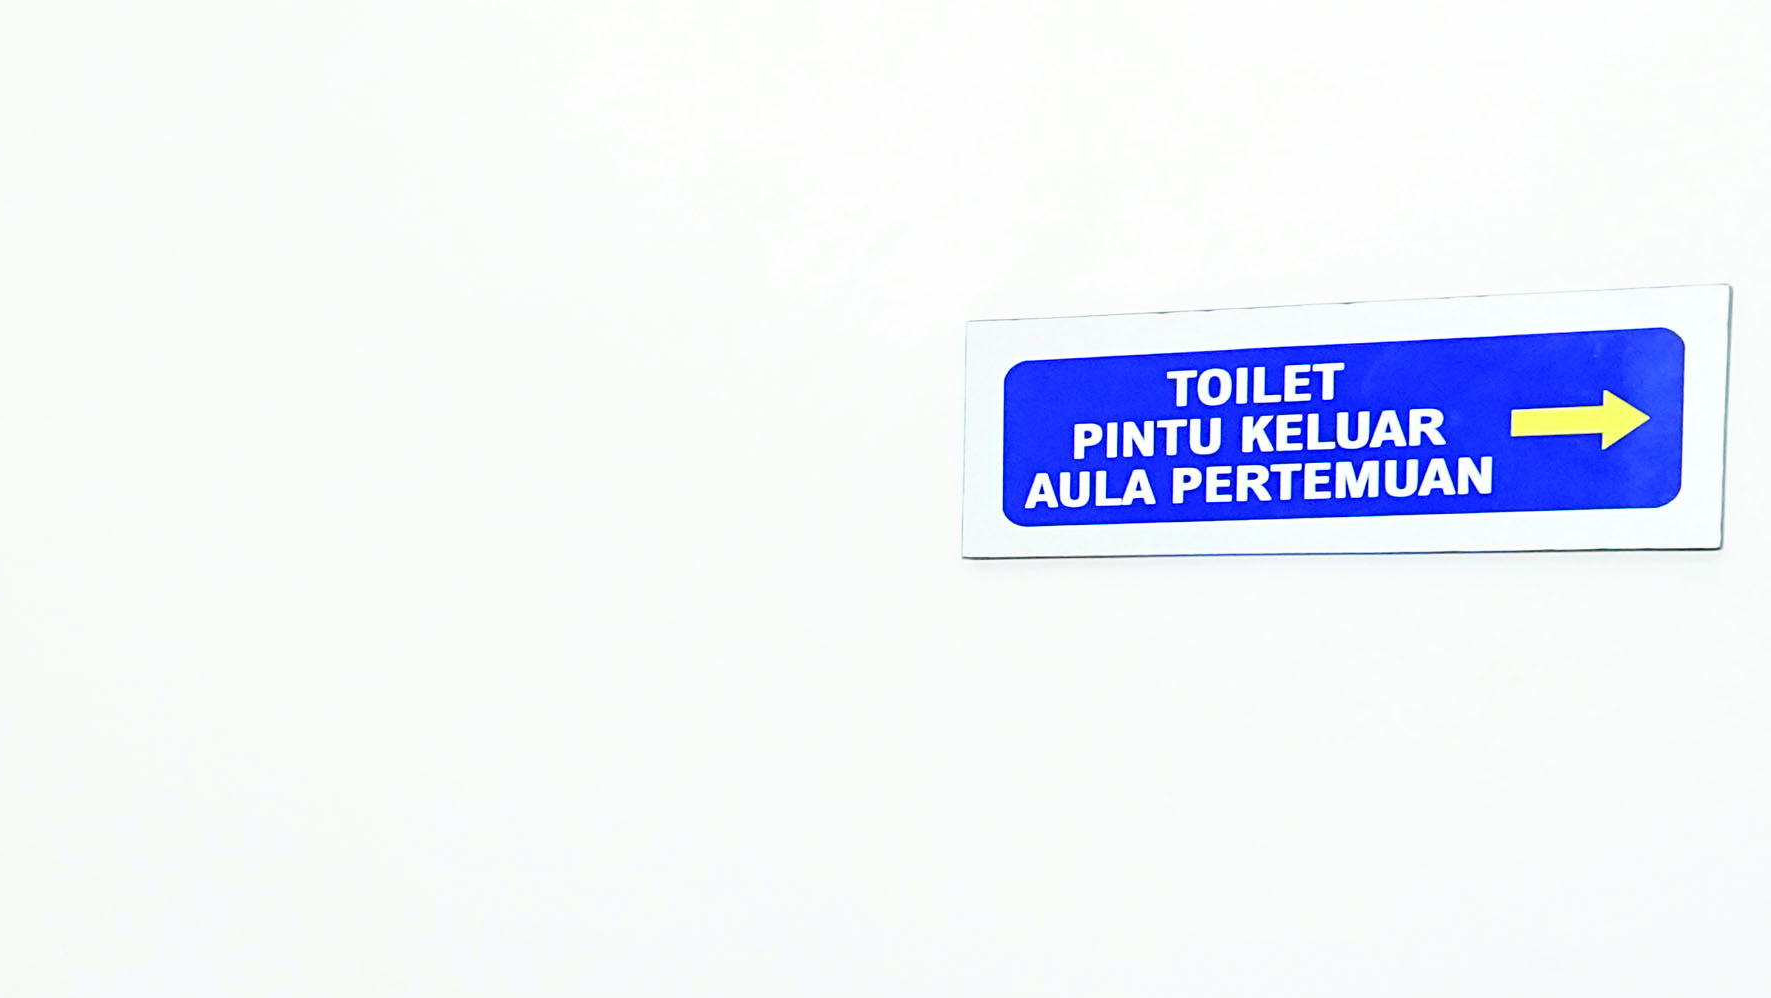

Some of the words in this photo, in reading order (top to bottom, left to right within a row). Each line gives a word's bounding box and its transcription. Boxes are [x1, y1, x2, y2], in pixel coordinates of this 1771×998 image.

[1167, 362, 1345, 407] TOILET
[1073, 418, 1222, 459] PINTU
[1242, 408, 1446, 453] KELUAR
[1024, 462, 1155, 509] AULA
[1172, 456, 1493, 503] PERTEMUAN
